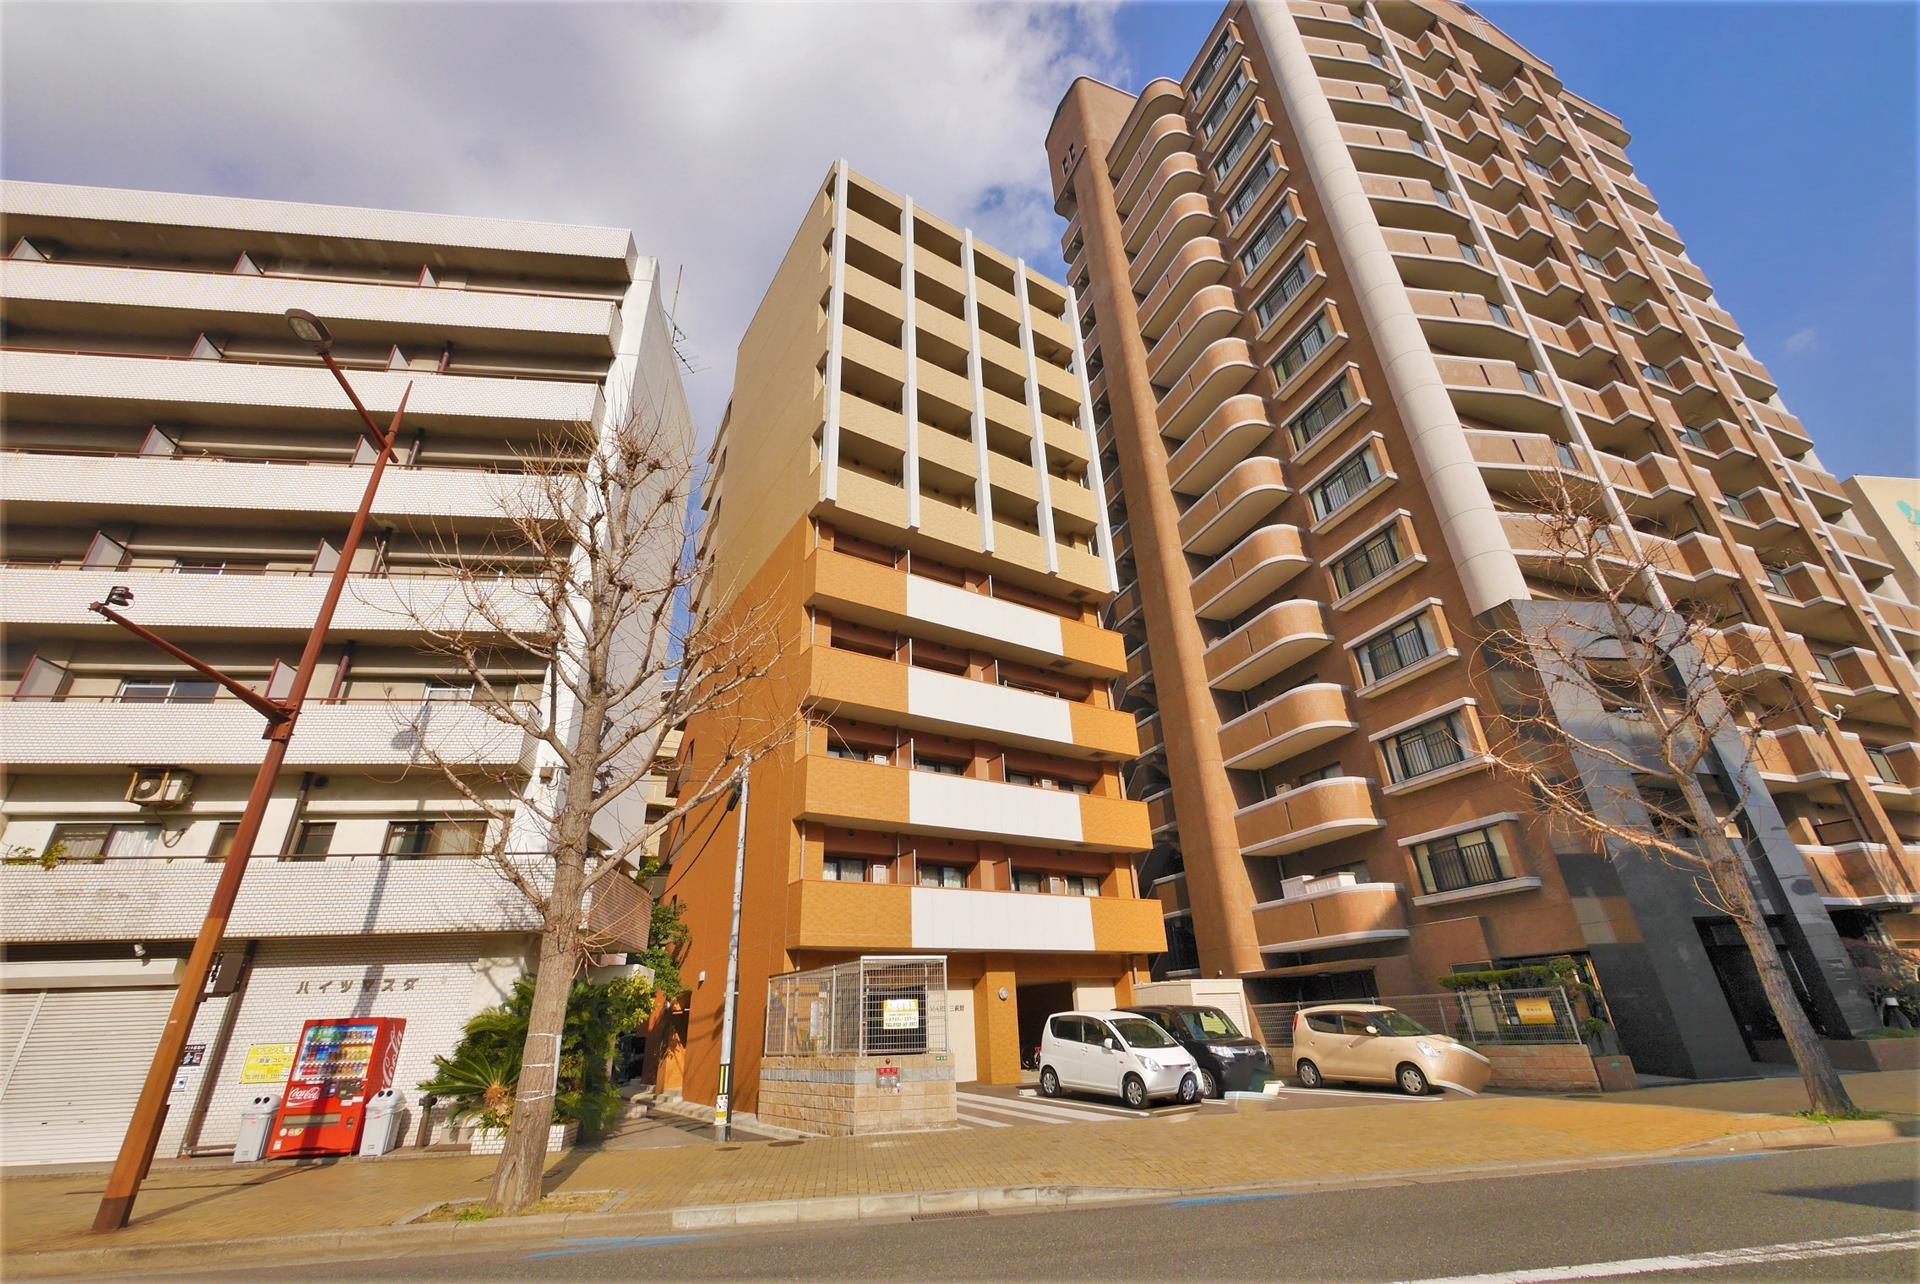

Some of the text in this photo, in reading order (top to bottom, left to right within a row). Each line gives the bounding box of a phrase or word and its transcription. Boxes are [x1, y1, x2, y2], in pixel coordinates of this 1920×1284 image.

[296, 978, 419, 994] ハイツマスダ
